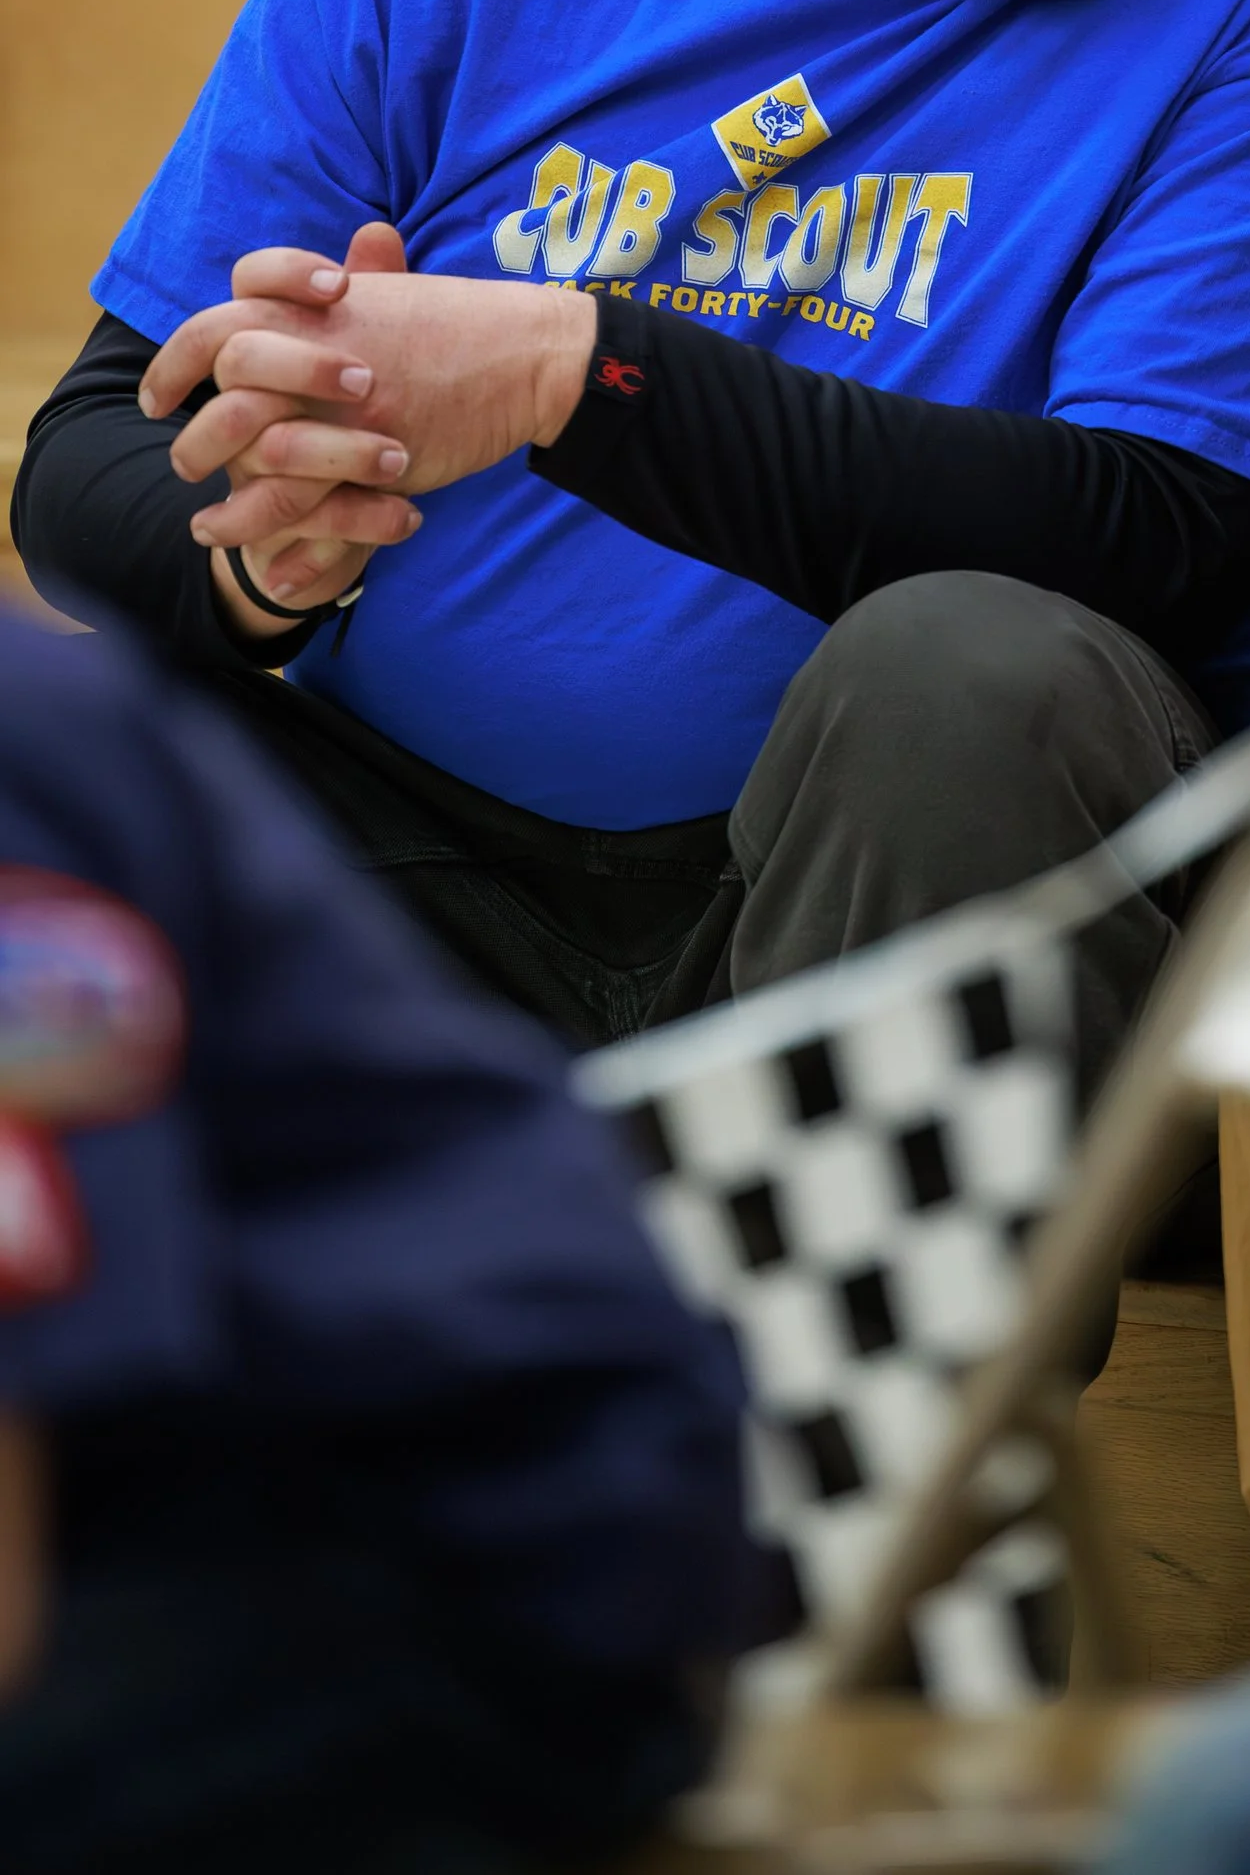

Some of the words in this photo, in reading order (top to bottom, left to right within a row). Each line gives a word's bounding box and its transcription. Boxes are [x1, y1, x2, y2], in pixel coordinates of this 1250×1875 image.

[729, 140, 756, 163] CUB
[492, 141, 676, 278] CUB
[682, 172, 974, 329] SCOUT
[649, 282, 875, 342] FORTY-FOUR
